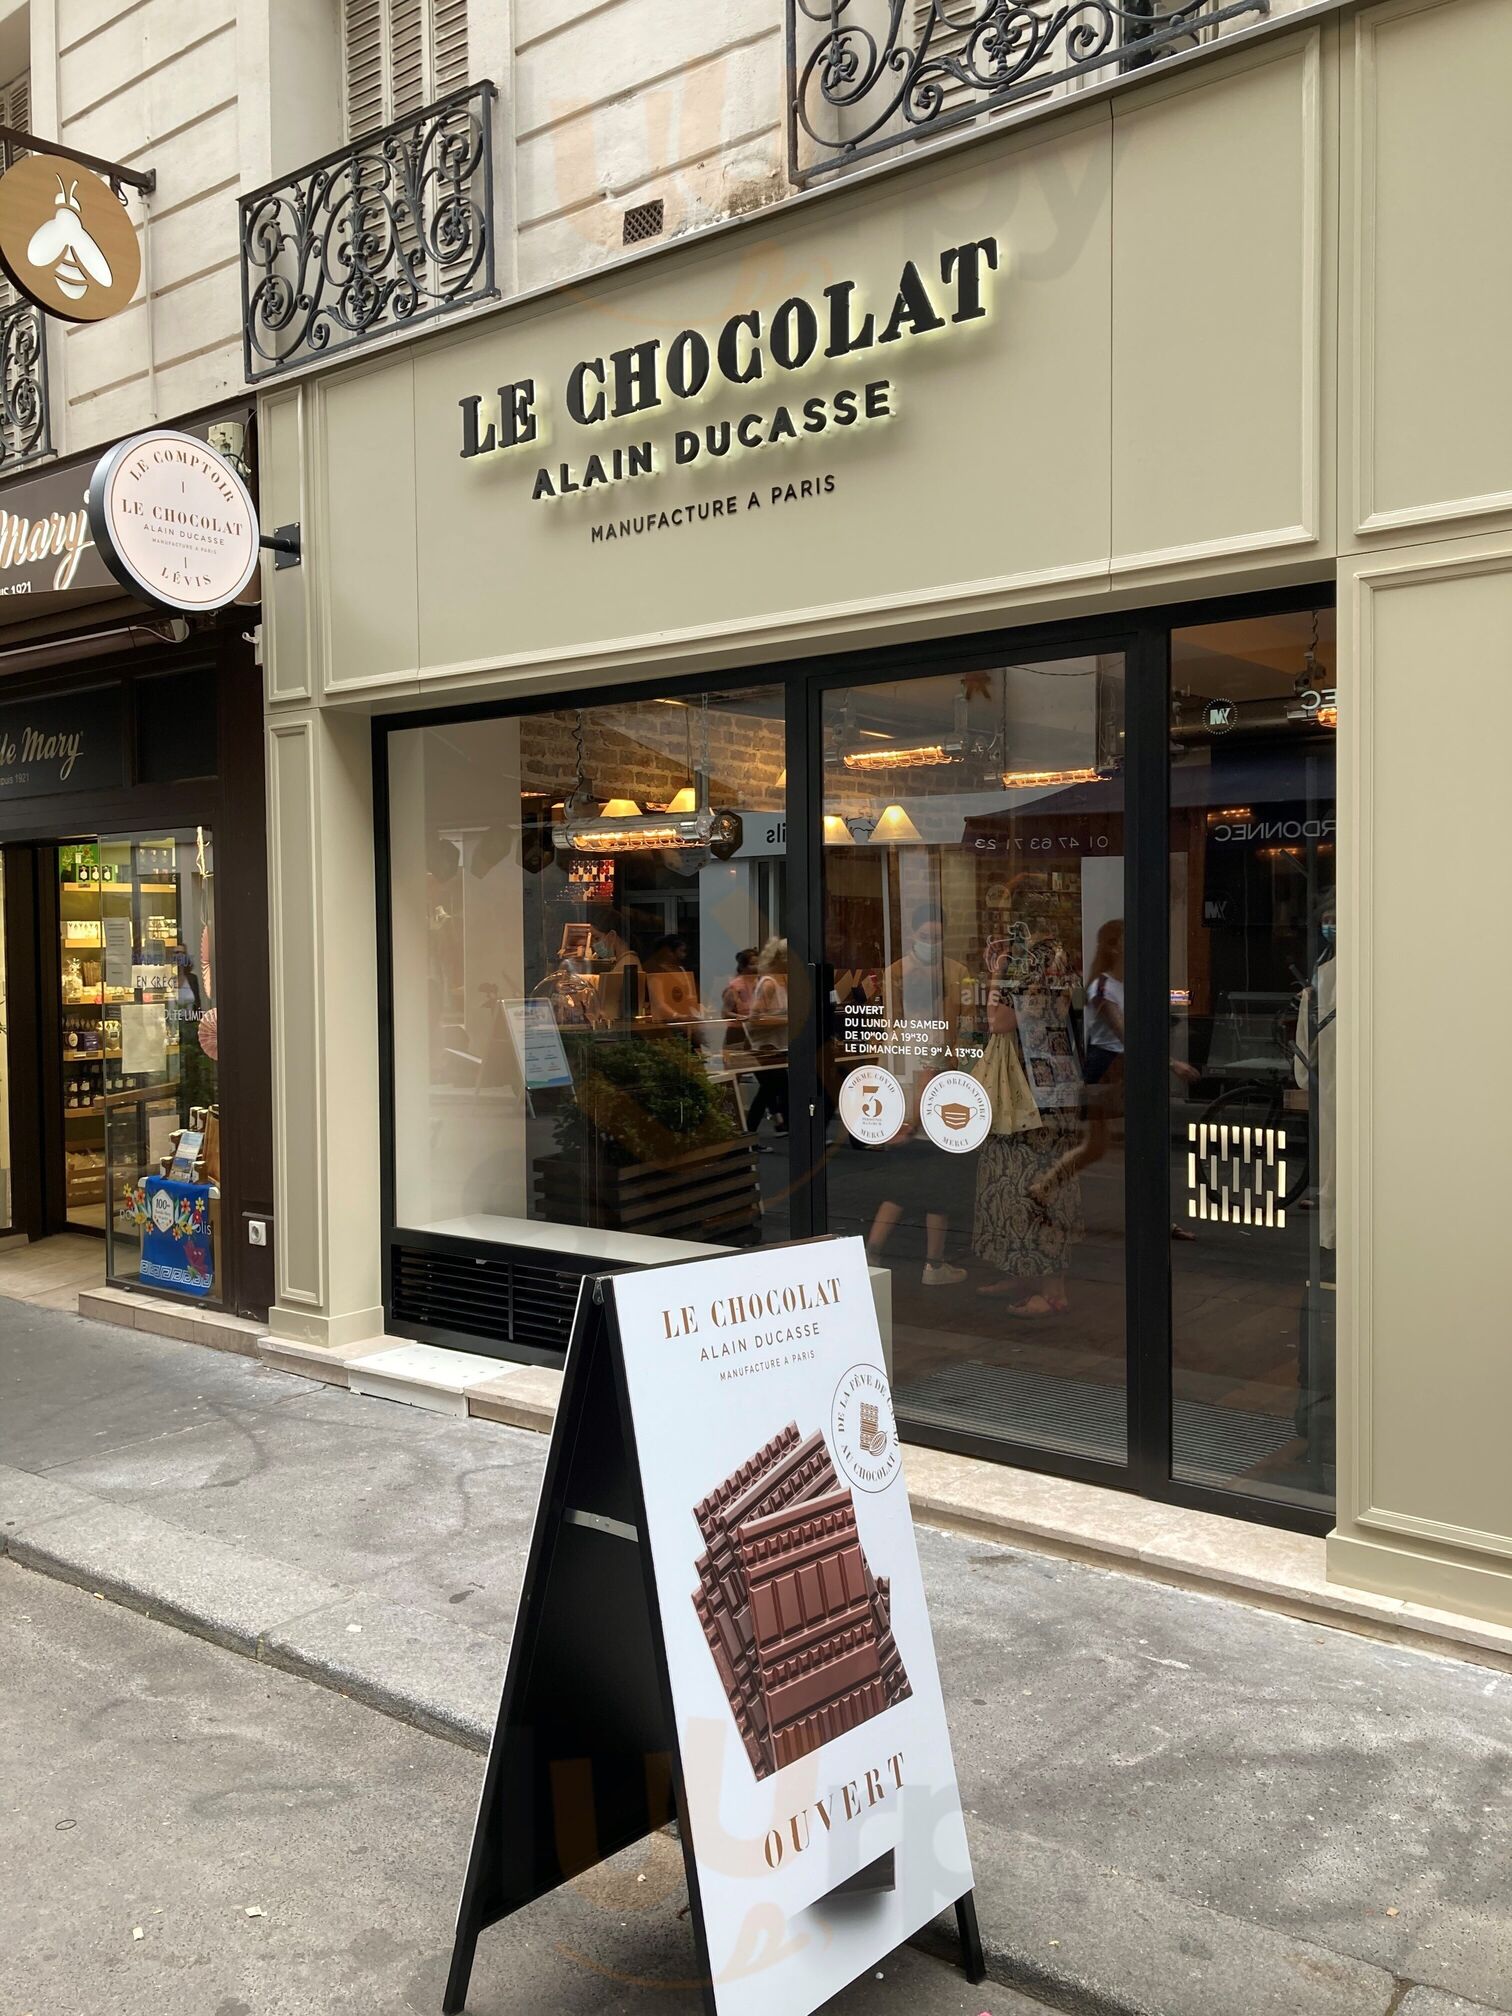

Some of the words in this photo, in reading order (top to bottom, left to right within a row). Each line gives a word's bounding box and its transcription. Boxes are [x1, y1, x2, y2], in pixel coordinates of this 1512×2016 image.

[459, 379, 537, 459] LE
[566, 236, 999, 425] CHOCOLAT
[532, 441, 653, 500] ALAIN
[675, 380, 891, 465] DUCASSE
[129, 459, 149, 481] LE
[153, 450, 234, 502] COMPTOIR
[122, 499, 144, 516] LE
[153, 506, 242, 536] CHOCOLAT
[591, 496, 738, 543] MANUFACTURE
[747, 491, 761, 508] A
[771, 474, 836, 505] PARIS
[0, 510, 95, 590] Mary
[143, 524, 174, 536] ALAIN
[180, 530, 225, 546] DUCASSE
[161, 567, 212, 587] LÉVIS
[21, 726, 84, 782] Mary
[844, 1005, 885, 1015] OUVERT
[845, 1018, 859, 1027] DU
[861, 1018, 891, 1028] LUNDI
[893, 1020, 907, 1029] AU
[910, 1020, 949, 1030] SAMEDI
[845, 1031, 858, 1040] DE
[860, 1031, 889, 1041] 10H00
[891, 1031, 899, 1041] À
[901, 1033, 929, 1043] 19H30
[845, 1044, 857, 1053] LE
[859, 1044, 911, 1055] DIMANCHE
[914, 1047, 928, 1056] DE
[944, 1046, 953, 1057] À
[955, 1048, 984, 1058] 13H30
[874, 1072, 896, 1094] COVID
[926, 1079, 945, 1116] MASQUE
[946, 1077, 986, 1121] OBLIGATOIRE
[860, 1129, 886, 1139] MERCI
[943, 1136, 969, 1147] MERCI
[661, 1306, 699, 1340] LE
[711, 1277, 841, 1327] CHOCOLAT
[700, 1338, 747, 1362] ALAIN
[754, 1322, 820, 1348] DUCASSE
[720, 1359, 781, 1382] MANUFACTURE
[792, 1350, 815, 1363] PARIS
[839, 1391, 850, 1408] LA
[874, 1379, 887, 1397] DE
[838, 1412, 845, 1432] DE
[841, 1444, 854, 1463] AU
[853, 1452, 896, 1481] CHOCOLAT
[764, 1752, 904, 1869] OUVERT
